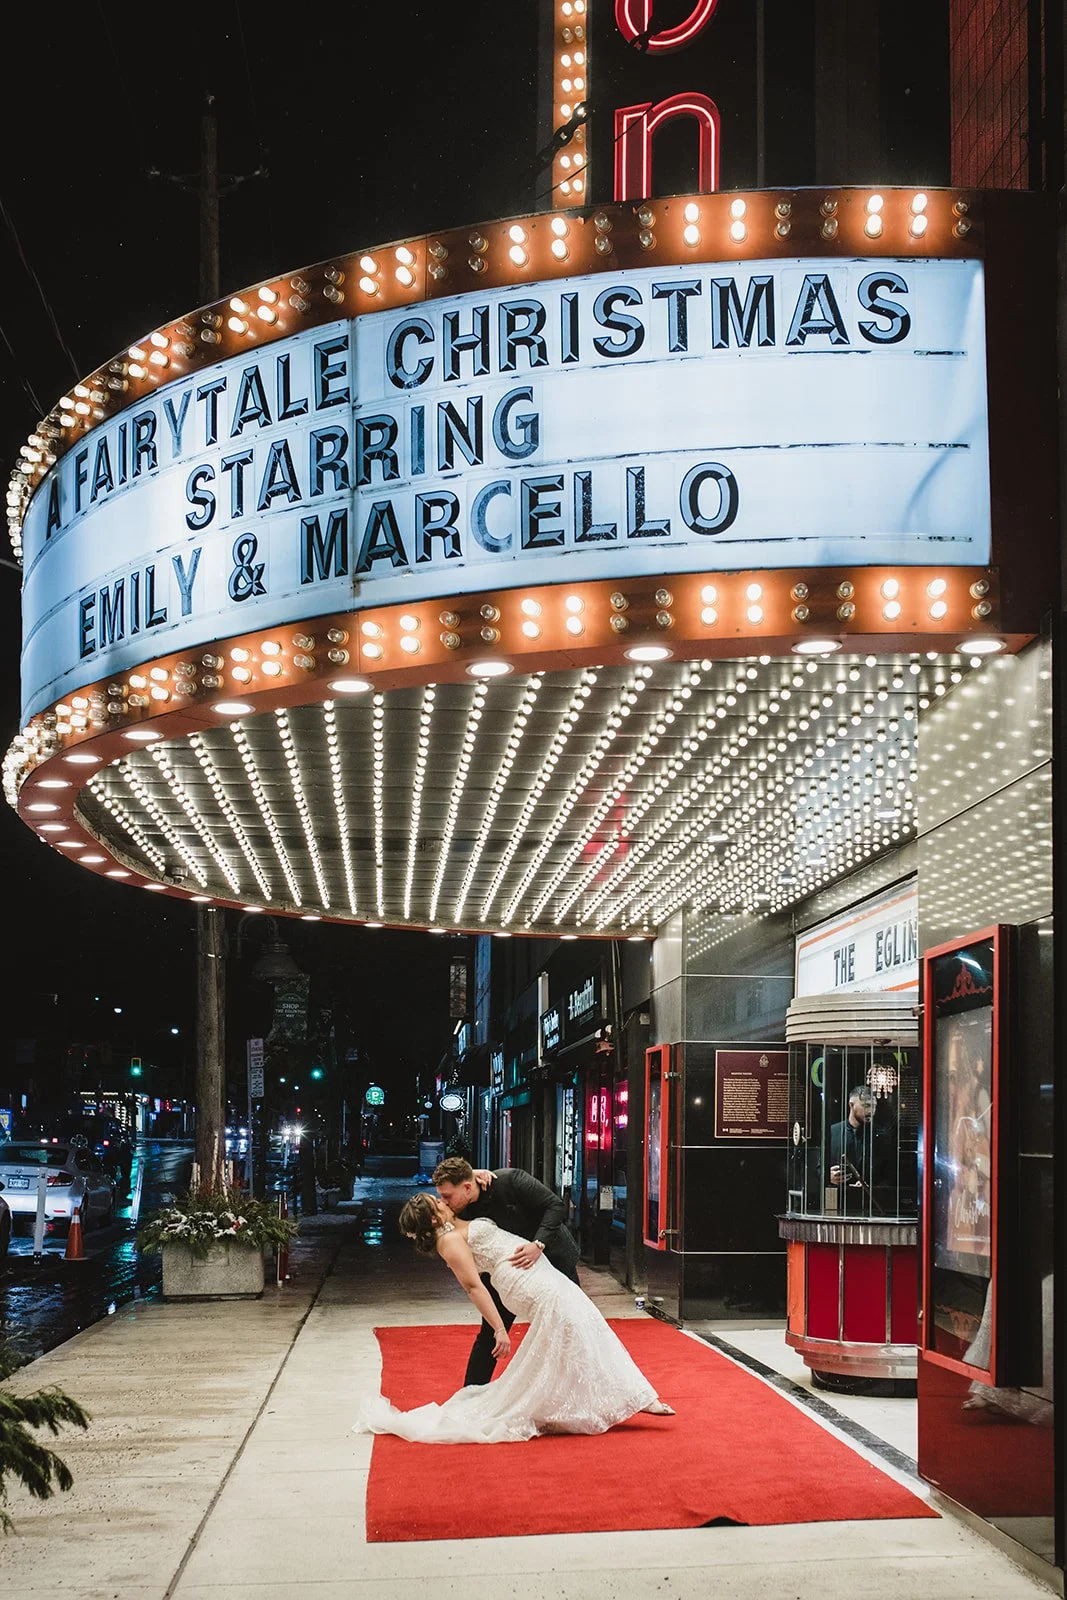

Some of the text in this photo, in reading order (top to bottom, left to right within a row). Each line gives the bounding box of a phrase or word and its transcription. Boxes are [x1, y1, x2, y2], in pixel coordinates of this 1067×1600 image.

[46, 271, 911, 540] A FAIRYTALE CHRISTMAS
[185, 386, 540, 531] STARRING
[79, 462, 739, 659] EMILY & MARCELLO
[281, 1002, 300, 1010] SHOP
[833, 942, 856, 987] THE
